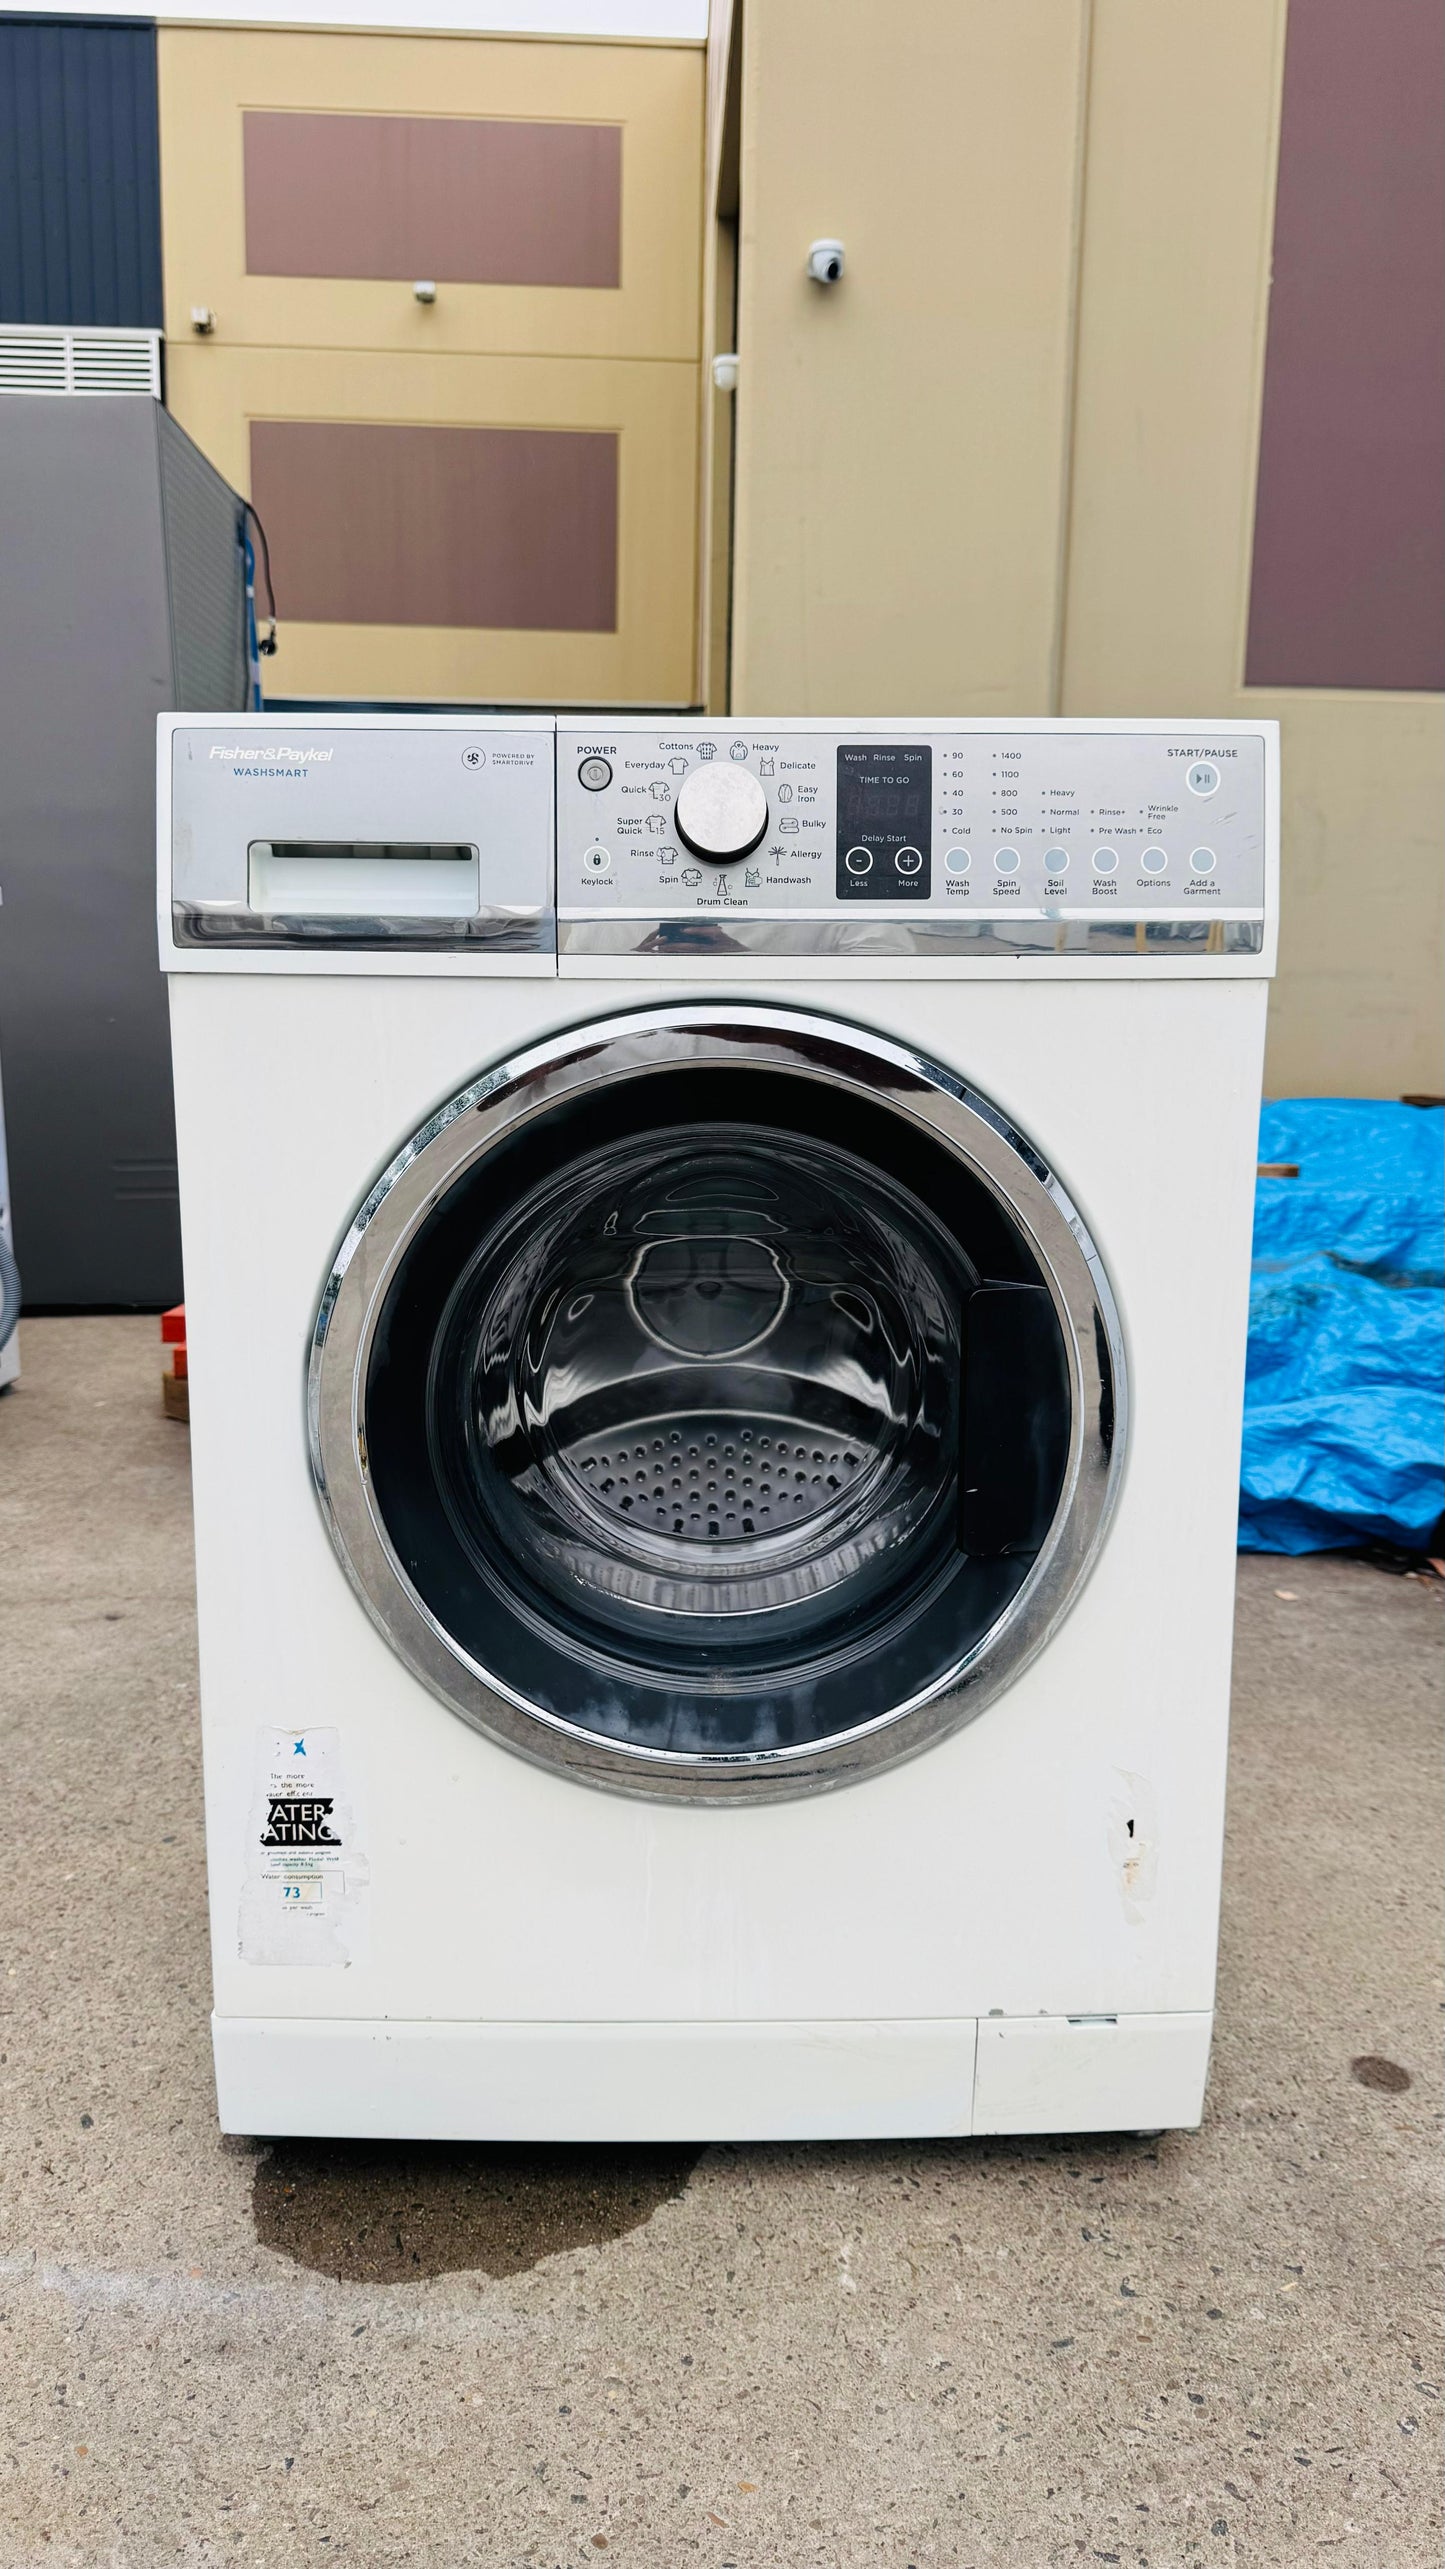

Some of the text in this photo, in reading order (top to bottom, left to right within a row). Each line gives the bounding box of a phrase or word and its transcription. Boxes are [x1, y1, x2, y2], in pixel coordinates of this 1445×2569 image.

[577, 746, 617, 754] POWER
[658, 742, 694, 751] Cottons
[752, 743, 780, 752] Heavy
[209, 746, 334, 764] Fisher&Paykel
[1167, 749, 1238, 758] START/PAUSE
[904, 754, 922, 763] Spin
[624, 761, 666, 770] Everyday
[780, 761, 816, 770] Delicate
[233, 768, 308, 778] WASHSMART
[621, 785, 647, 794] Quick
[798, 785, 818, 794] Easy
[1050, 790, 1075, 798] Heavy
[658, 794, 671, 802] 30
[798, 795, 816, 803] Iron
[617, 817, 642, 827] Super
[802, 820, 826, 829] Bulky
[617, 827, 642, 835] Quick
[1016, 827, 1032, 836] Spin
[790, 850, 822, 859] Allergy
[581, 878, 614, 887] Keylock
[659, 876, 679, 885] Spin
[766, 876, 811, 885] Handwash
[997, 880, 1016, 888] Spin
[1136, 879, 1171, 888] Options
[946, 888, 969, 896] Temp
[993, 888, 1020, 896] Speed
[1184, 888, 1221, 896] Garment
[696, 898, 748, 906] Drum Clean
[270, 1804, 326, 1822] ATER
[283, 1887, 300, 1898] 73
